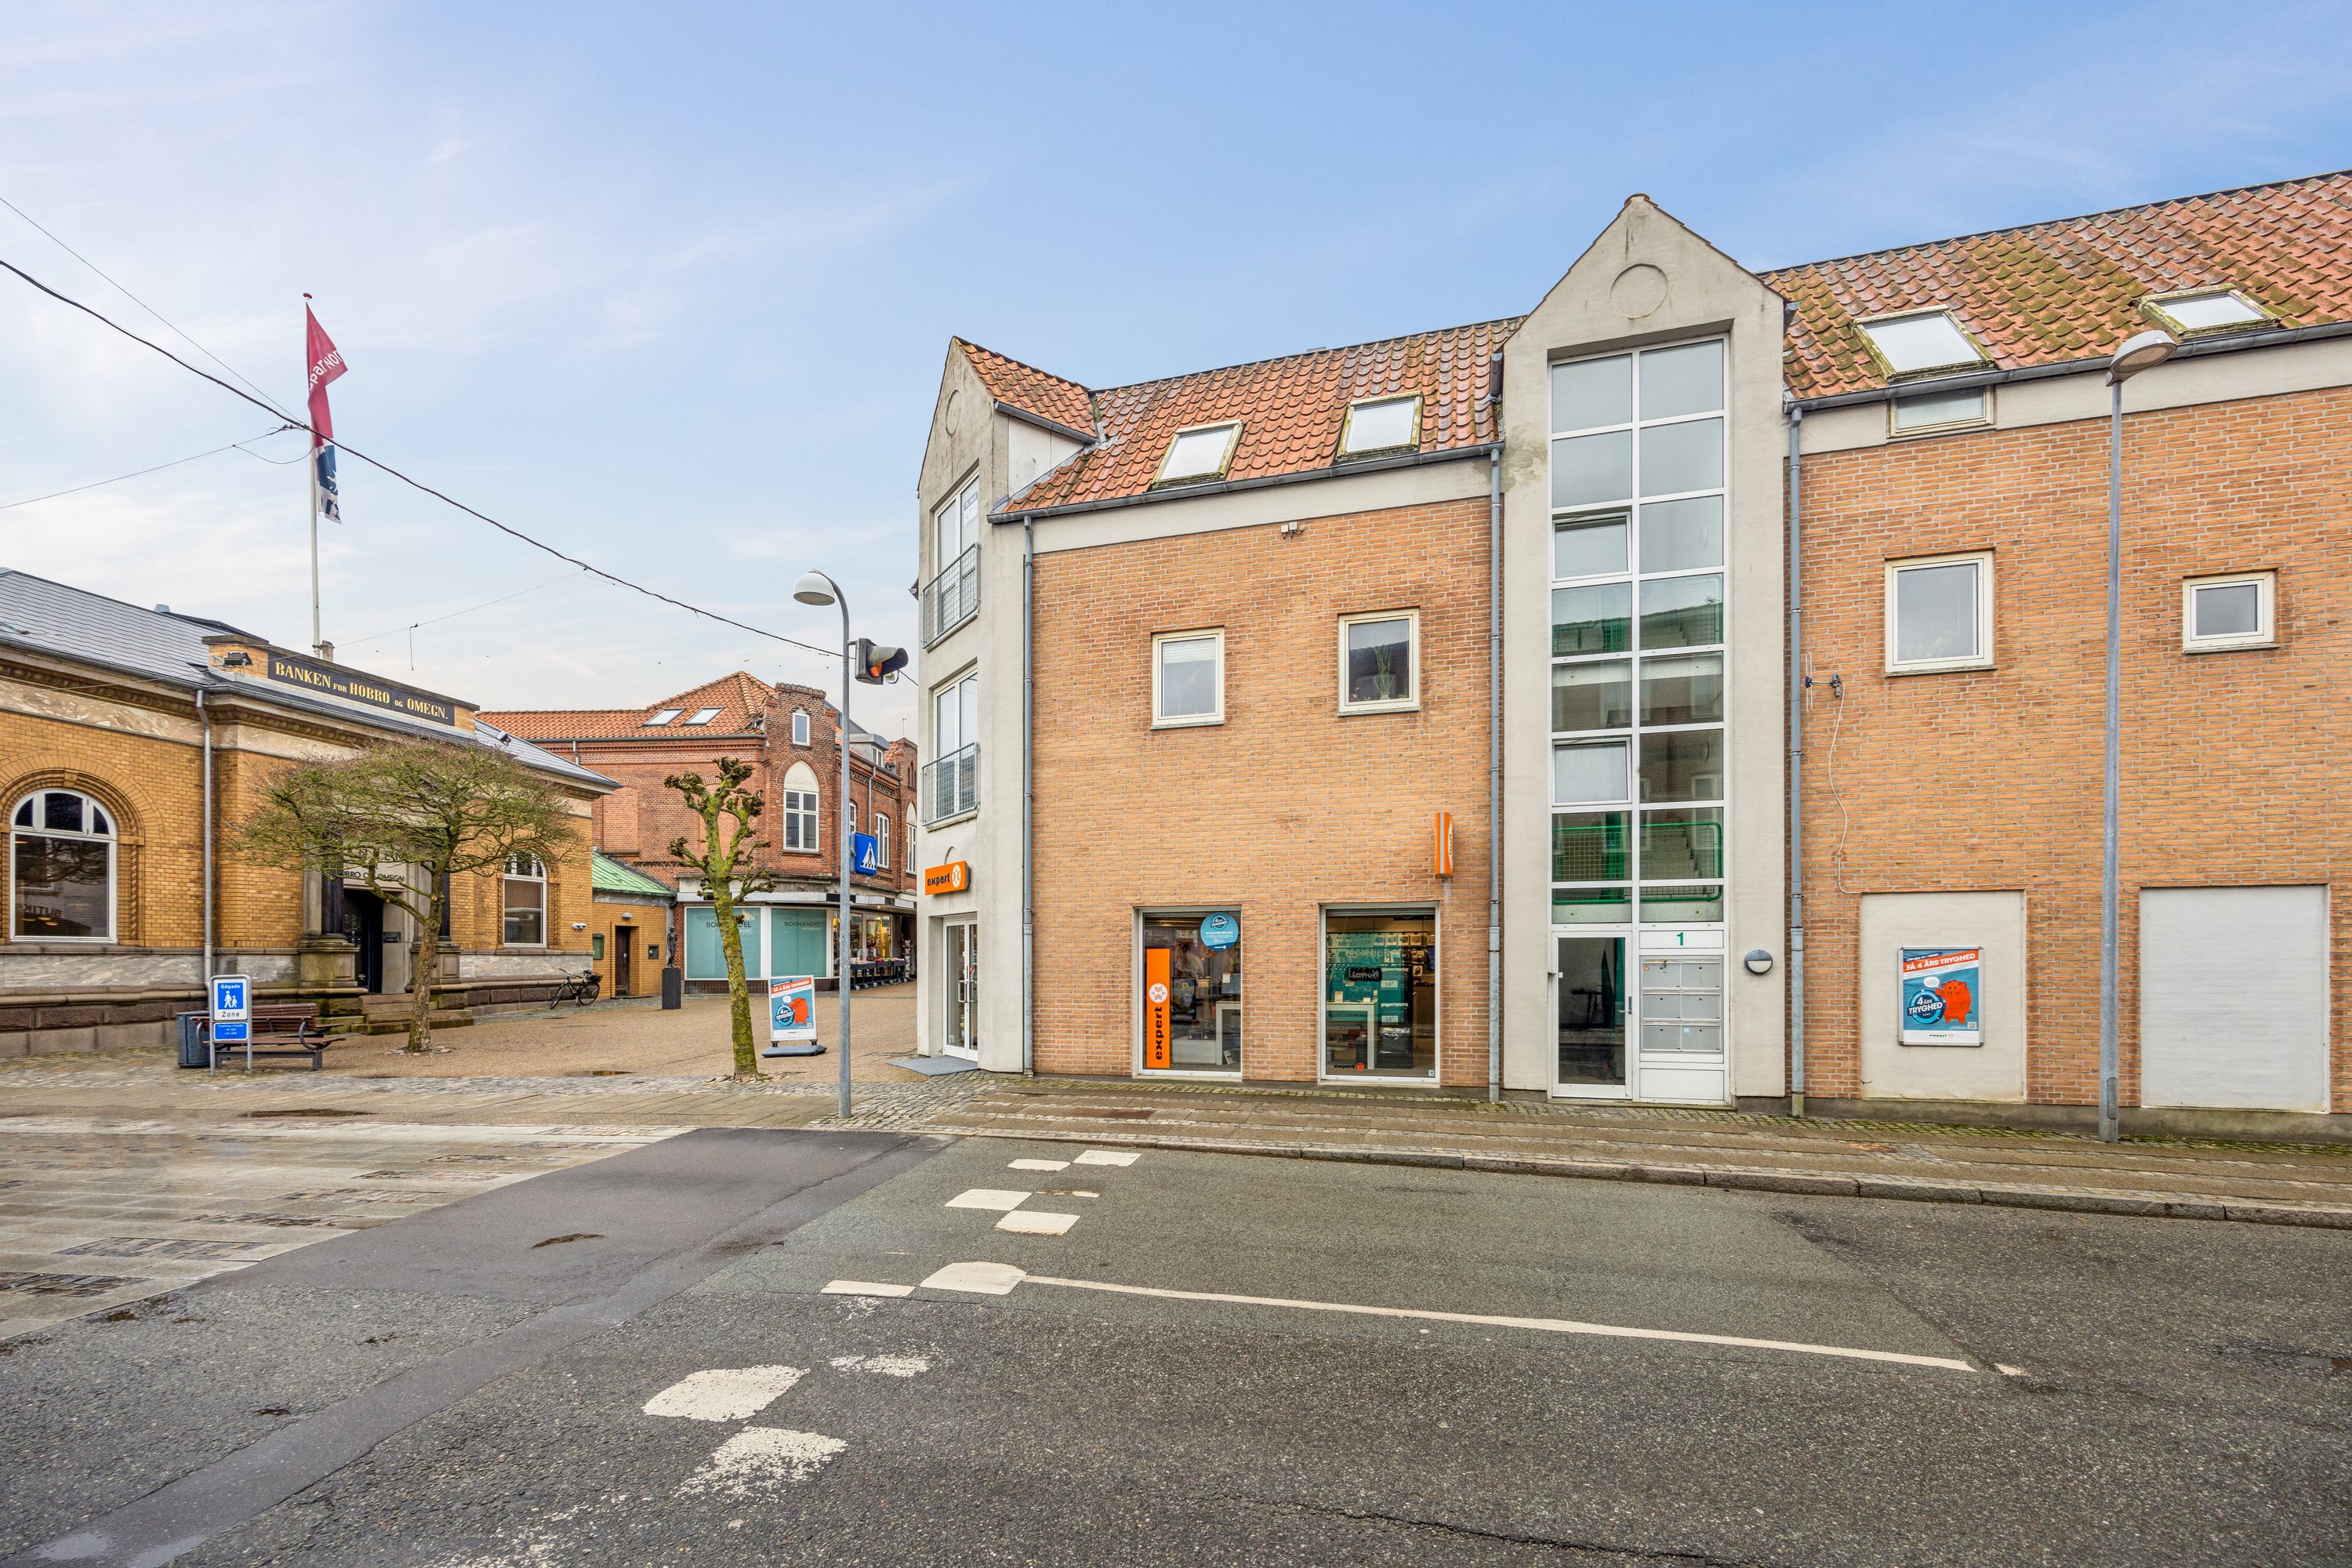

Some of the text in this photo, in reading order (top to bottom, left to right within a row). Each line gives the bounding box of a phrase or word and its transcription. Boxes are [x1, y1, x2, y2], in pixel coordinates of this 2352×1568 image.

[310, 350, 343, 390] parNor
[275, 661, 448, 719] BANKEN FOR HOBRO OG OMEGN.
[927, 873, 950, 887] expert
[1677, 932, 1684, 946] 1
[1906, 962, 1916, 971] FÅ
[1924, 959, 1939, 967] ÅRS
[1940, 953, 1975, 965] TRYGHED
[1908, 1002, 1943, 1015] TRYGHED
[1917, 997, 1923, 1005] 4
[1154, 1007, 1164, 1060] expert
